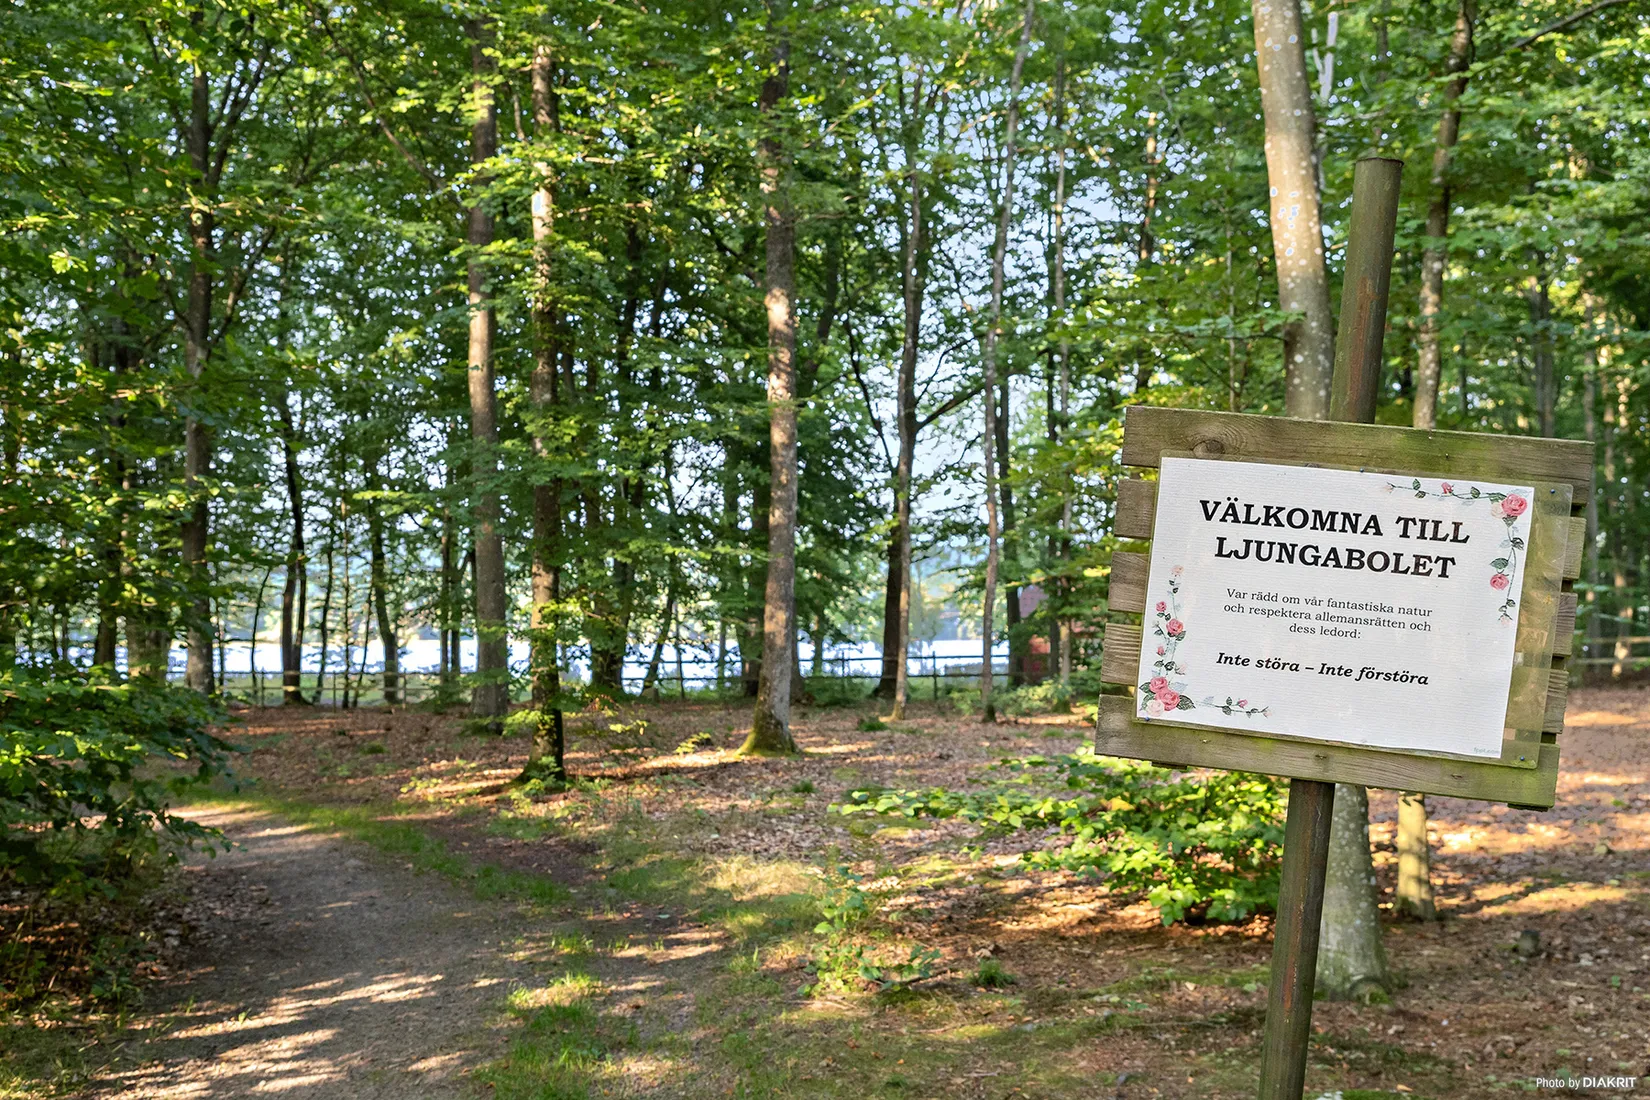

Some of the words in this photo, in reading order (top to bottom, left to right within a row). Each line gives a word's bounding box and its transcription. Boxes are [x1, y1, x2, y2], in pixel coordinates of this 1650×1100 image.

[1199, 497, 1384, 537] VÄLKOMNA
[1394, 515, 1471, 544] TILL
[1214, 536, 1457, 579] LJUNGABOLET
[1223, 603, 1245, 614] och
[1248, 607, 1312, 622] respektera
[1314, 611, 1406, 630] allemansrätten
[1409, 621, 1432, 632] och
[1226, 588, 1248, 600] Var
[1251, 591, 1279, 603] rädd
[1281, 596, 1300, 605] om
[1304, 595, 1324, 607] vår
[1326, 598, 1394, 614] fantastiska
[1397, 606, 1433, 617] natur
[1289, 622, 1316, 635] dess
[1319, 625, 1361, 639] ledord:
[1215, 652, 1251, 667] Inte
[1254, 656, 1300, 673] störa
[1317, 662, 1354, 678] Inte
[1354, 666, 1429, 686] förstöra
